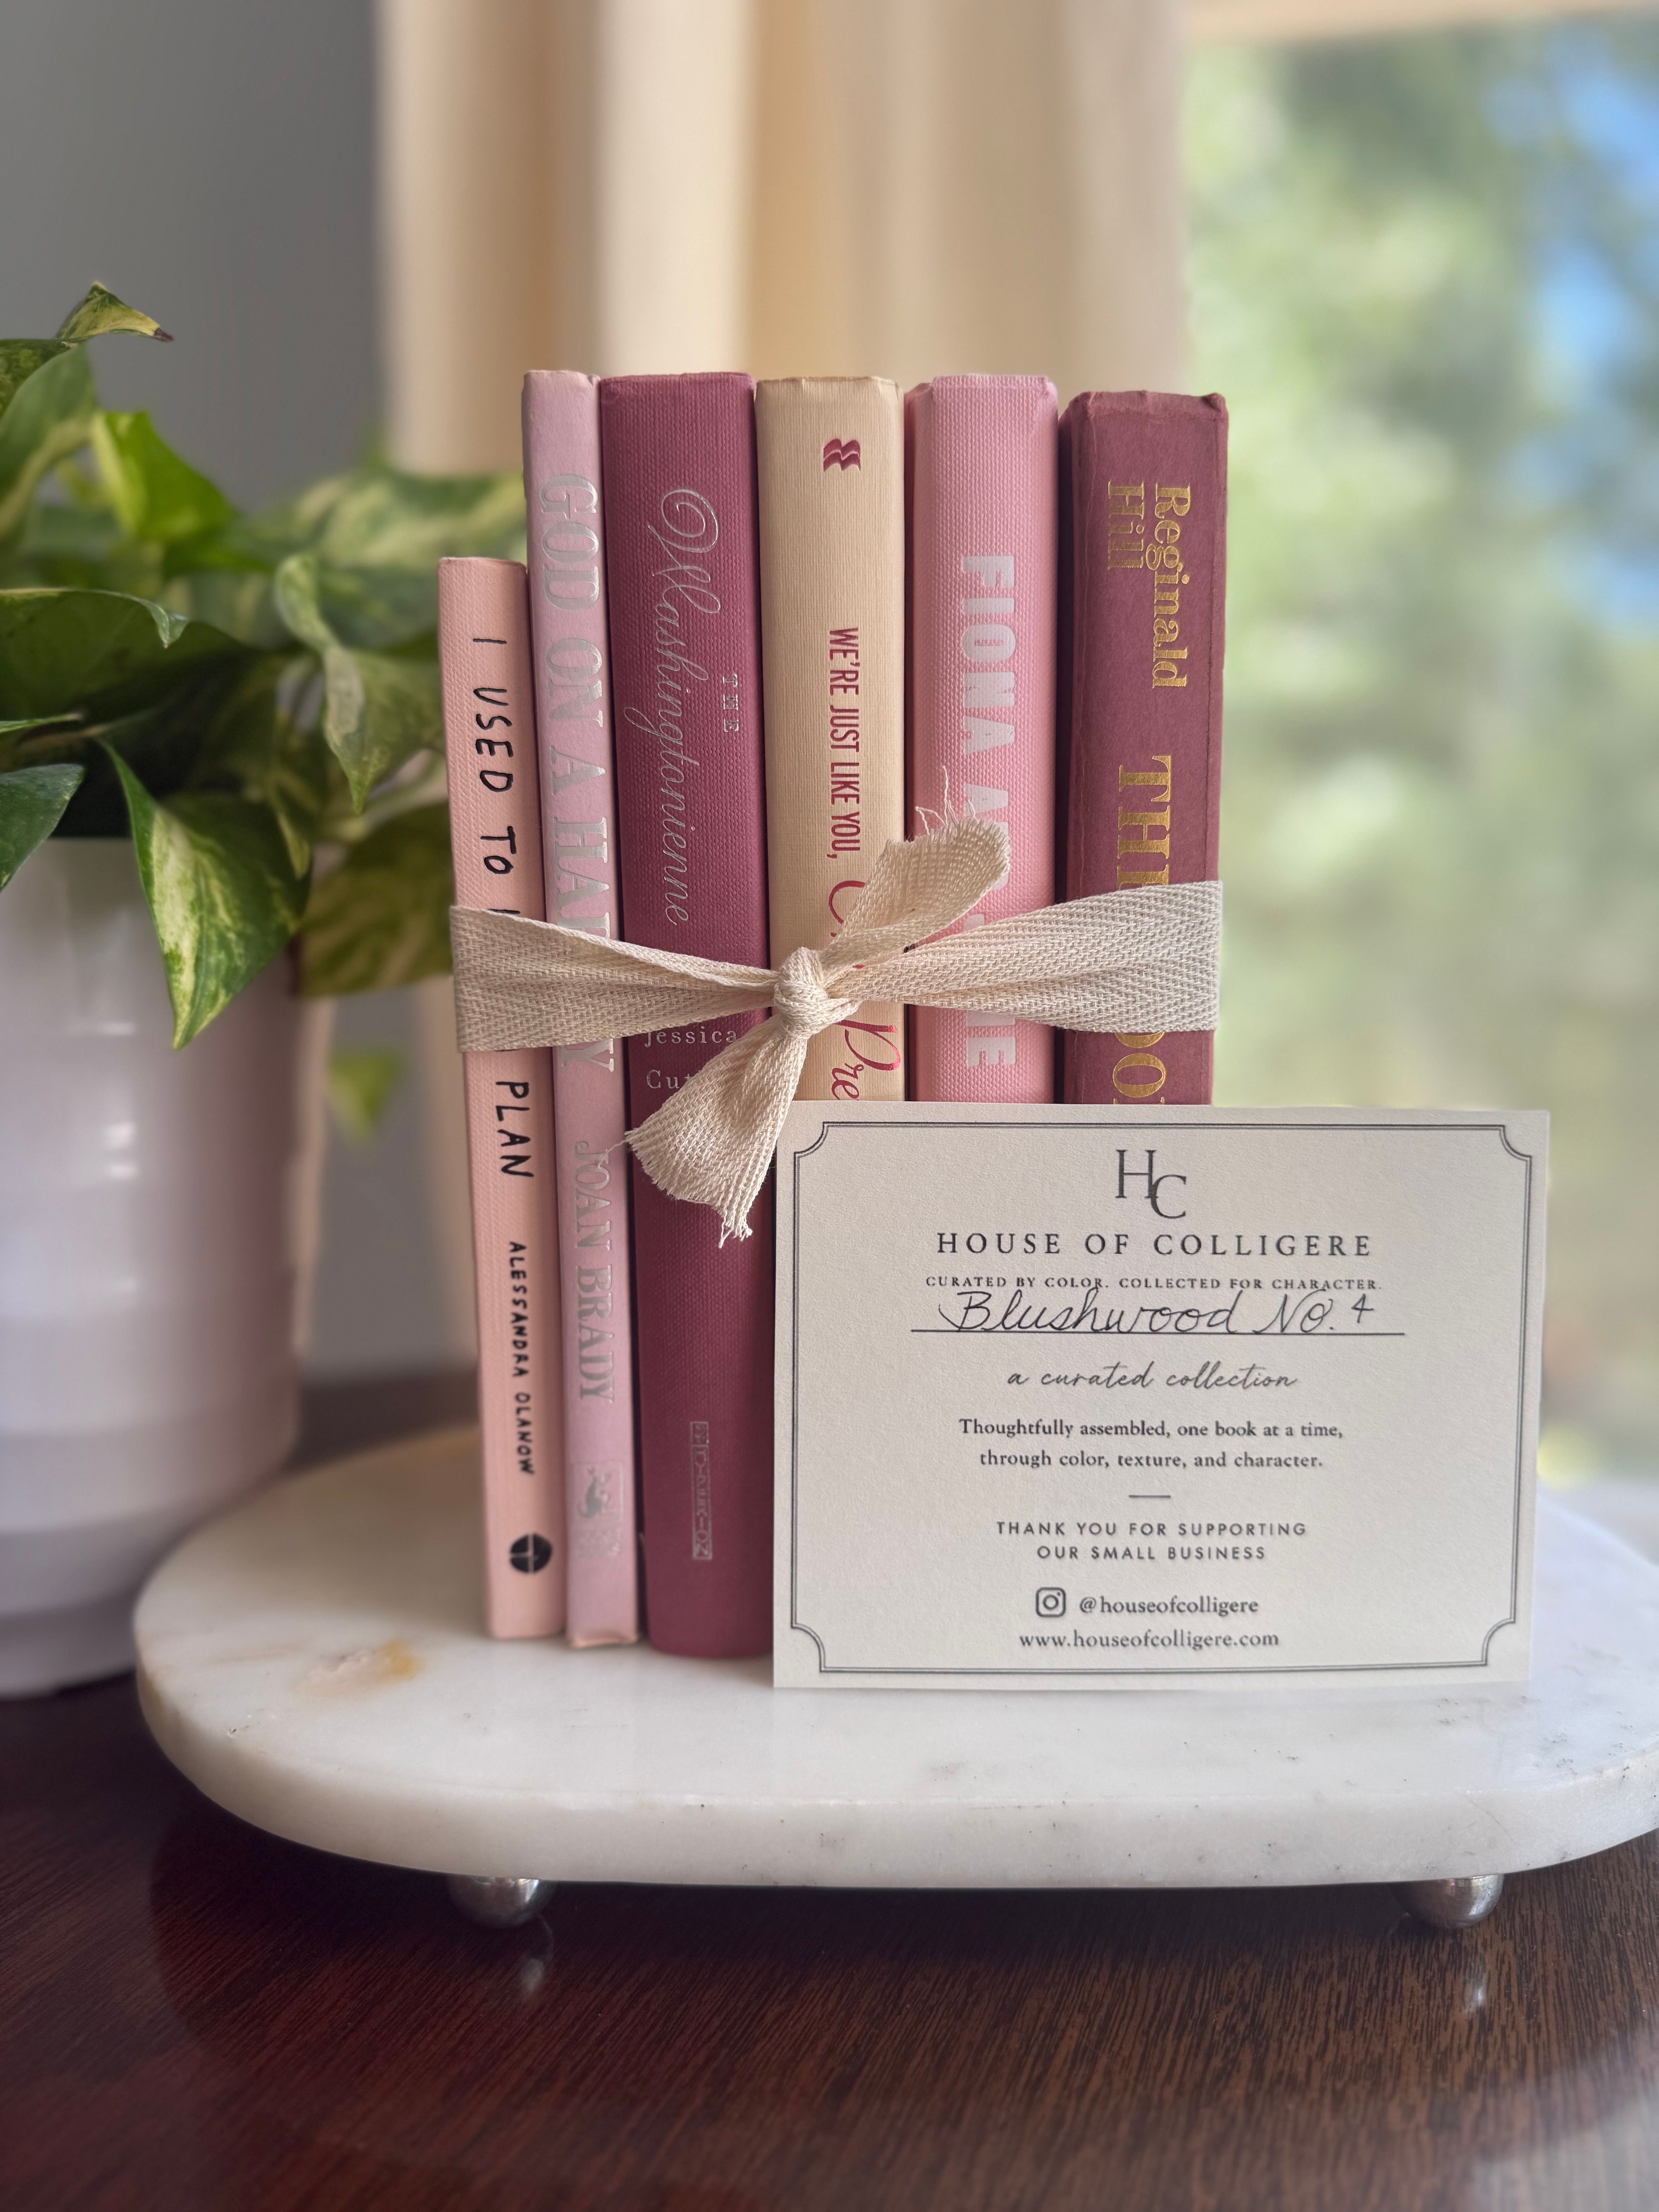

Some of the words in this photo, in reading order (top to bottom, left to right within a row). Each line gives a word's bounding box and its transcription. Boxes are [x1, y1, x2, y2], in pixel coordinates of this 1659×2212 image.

[541, 474, 599, 612] GOD
[1108, 480, 1144, 570] Hill
[1145, 483, 1191, 689] Reginald
[473, 637, 507, 646] I
[829, 627, 860, 696] WE'RE
[962, 555, 1016, 755] FIONA
[546, 638, 604, 728] ON
[624, 488, 721, 926] Washingtonienne
[722, 674, 740, 733] THE
[473, 687, 514, 793] USED
[830, 705, 860, 753] JUST
[550, 746, 606, 796] A
[830, 762, 860, 805] LIKE
[480, 826, 517, 875] TO
[826, 812, 860, 859] YOU,
[553, 816, 615, 1072] HAY
[644, 1026, 737, 1048] Jessica
[496, 1080, 534, 1179] PLAN
[573, 1140, 611, 1252] JOAN
[936, 1233, 1061, 1255] HOUSE
[1084, 1234, 1129, 1255] OF
[1153, 1234, 1371, 1256] COLLIGERE
[926, 1276, 1006, 1288] CURATED
[1016, 1277, 1035, 1288] BY
[1044, 1277, 1109, 1289] COLOR.
[1118, 1278, 1220, 1289] COLLECTED
[1230, 1278, 1263, 1290] FOR
[1271, 1279, 1382, 1290] CHARACTER.
[508, 1241, 531, 1378] ALESSANDRA
[938, 1287, 1243, 1334] Blushwood
[1351, 1293, 1374, 1324] 4
[576, 1265, 615, 1404] BRADY
[1007, 1372, 1030, 1386] a
[1041, 1360, 1155, 1389] curated
[1166, 1360, 1298, 1390] collection
[515, 1392, 536, 1476] OLANOW
[958, 1418, 1074, 1439] Thoughtfully
[1080, 1420, 1171, 1438] assembled,
[1177, 1425, 1209, 1436] one
[1215, 1420, 1257, 1436] book
[1263, 1425, 1279, 1436] at
[1285, 1426, 1294, 1437] a
[1300, 1422, 1343, 1439] time,
[980, 1448, 1052, 1469] through
[1059, 1450, 1110, 1468] color,
[1118, 1455, 1187, 1469] texture,
[1194, 1451, 1227, 1467] and
[1234, 1451, 1323, 1468] character.
[996, 1521, 1066, 1536] THANK
[1076, 1522, 1117, 1536] YOU
[1129, 1523, 1166, 1537] FOR
[1178, 1522, 1307, 1537] SUPPORTING
[1037, 1545, 1079, 1560] OUR
[1091, 1546, 1156, 1561] SMALL
[1168, 1546, 1265, 1560] BUSINESS
[1079, 1595, 1259, 1618] @houseofcolligere
[1019, 1629, 1279, 1651] www.houseofcolligere.com
